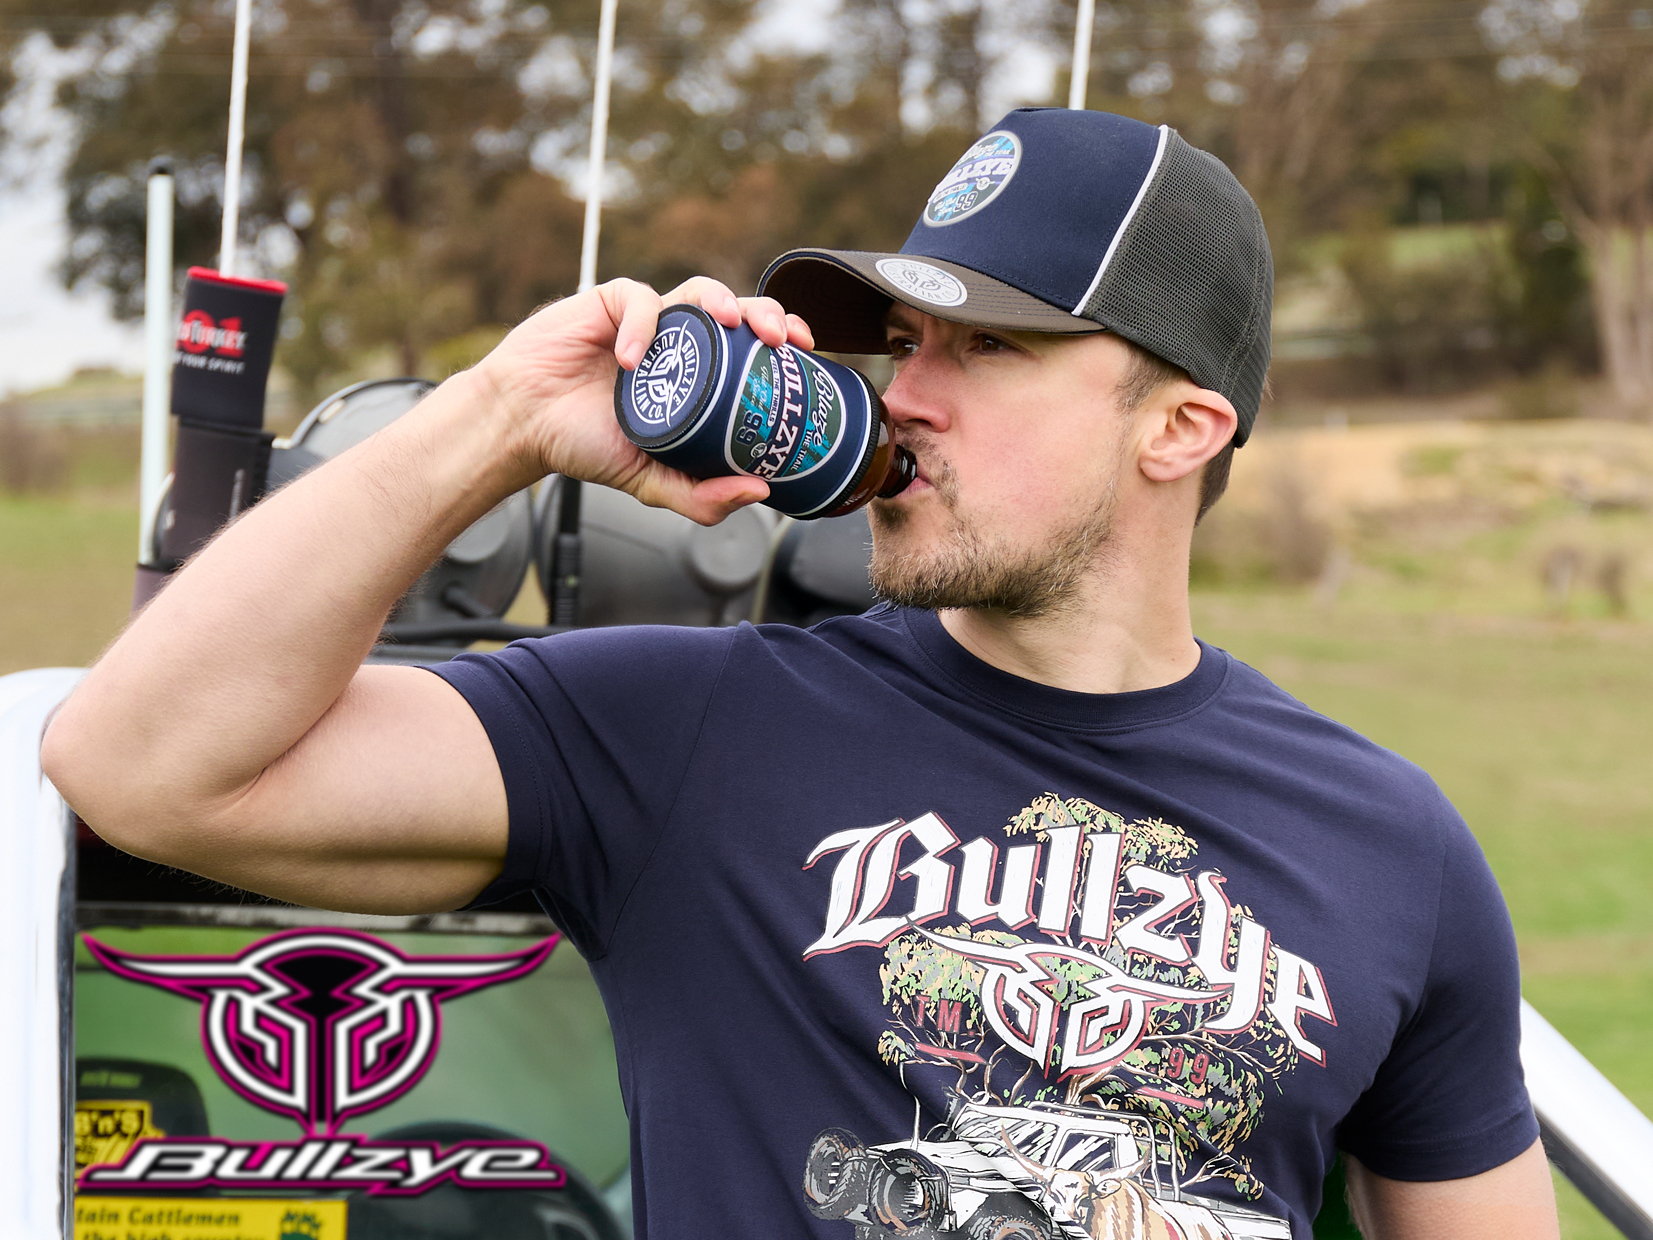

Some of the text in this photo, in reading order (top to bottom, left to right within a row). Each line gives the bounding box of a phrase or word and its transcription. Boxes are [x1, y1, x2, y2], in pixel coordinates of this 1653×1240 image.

[953, 191, 978, 212] 99
[635, 332, 676, 418] AUSTRALIAN CO.
[673, 339, 697, 406] BULLZYE
[735, 409, 763, 446] 99
[754, 345, 803, 480] BULLZYE
[769, 393, 780, 422] THRILLS
[812, 370, 835, 447] Blaze
[790, 430, 814, 471] THE TRAIL
[803, 812, 1338, 1067] Bullzye
[88, 1141, 560, 1188] Bullzye
[128, 1207, 242, 1226] Cattlemen
